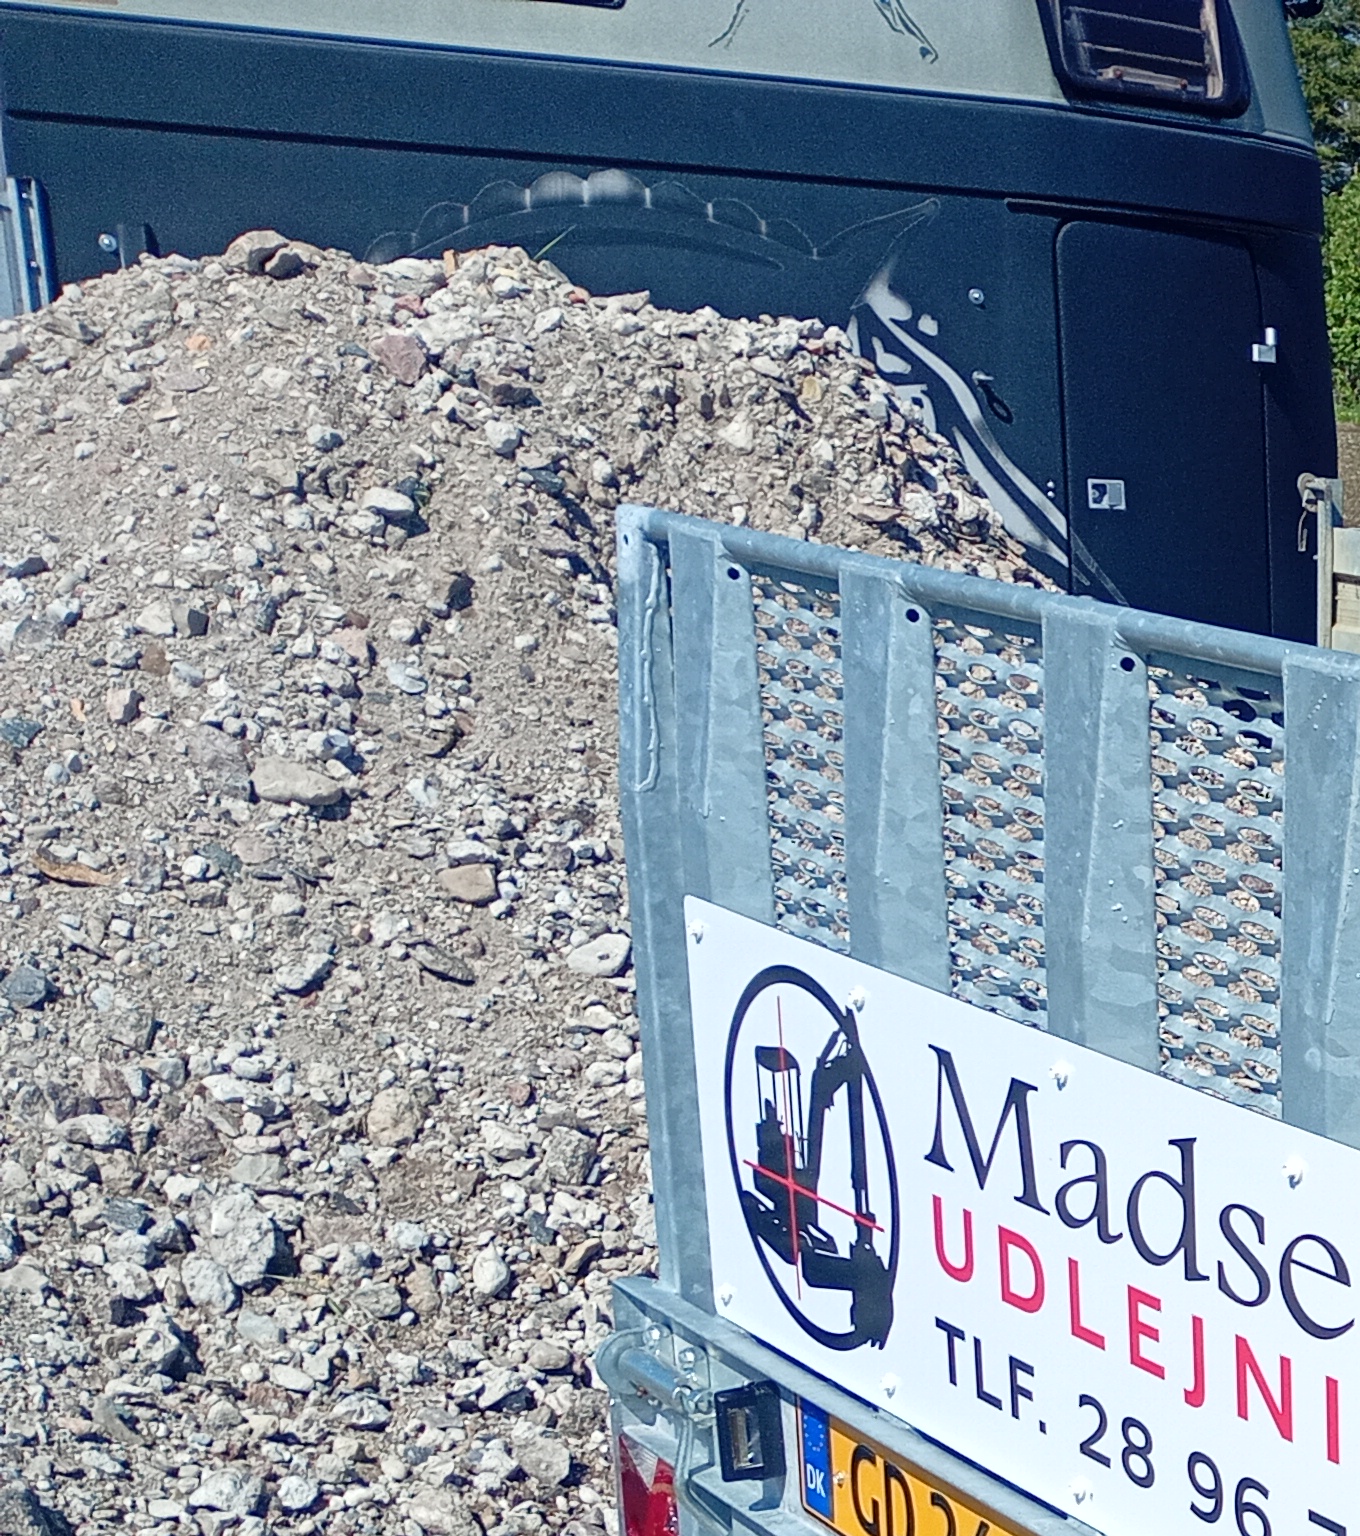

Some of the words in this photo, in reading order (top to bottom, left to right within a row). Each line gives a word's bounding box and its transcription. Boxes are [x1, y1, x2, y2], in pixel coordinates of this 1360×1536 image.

[935, 1316, 1047, 1435] TLF.
[1078, 1393, 1155, 1489] 28
[806, 1463, 826, 1498] DK
